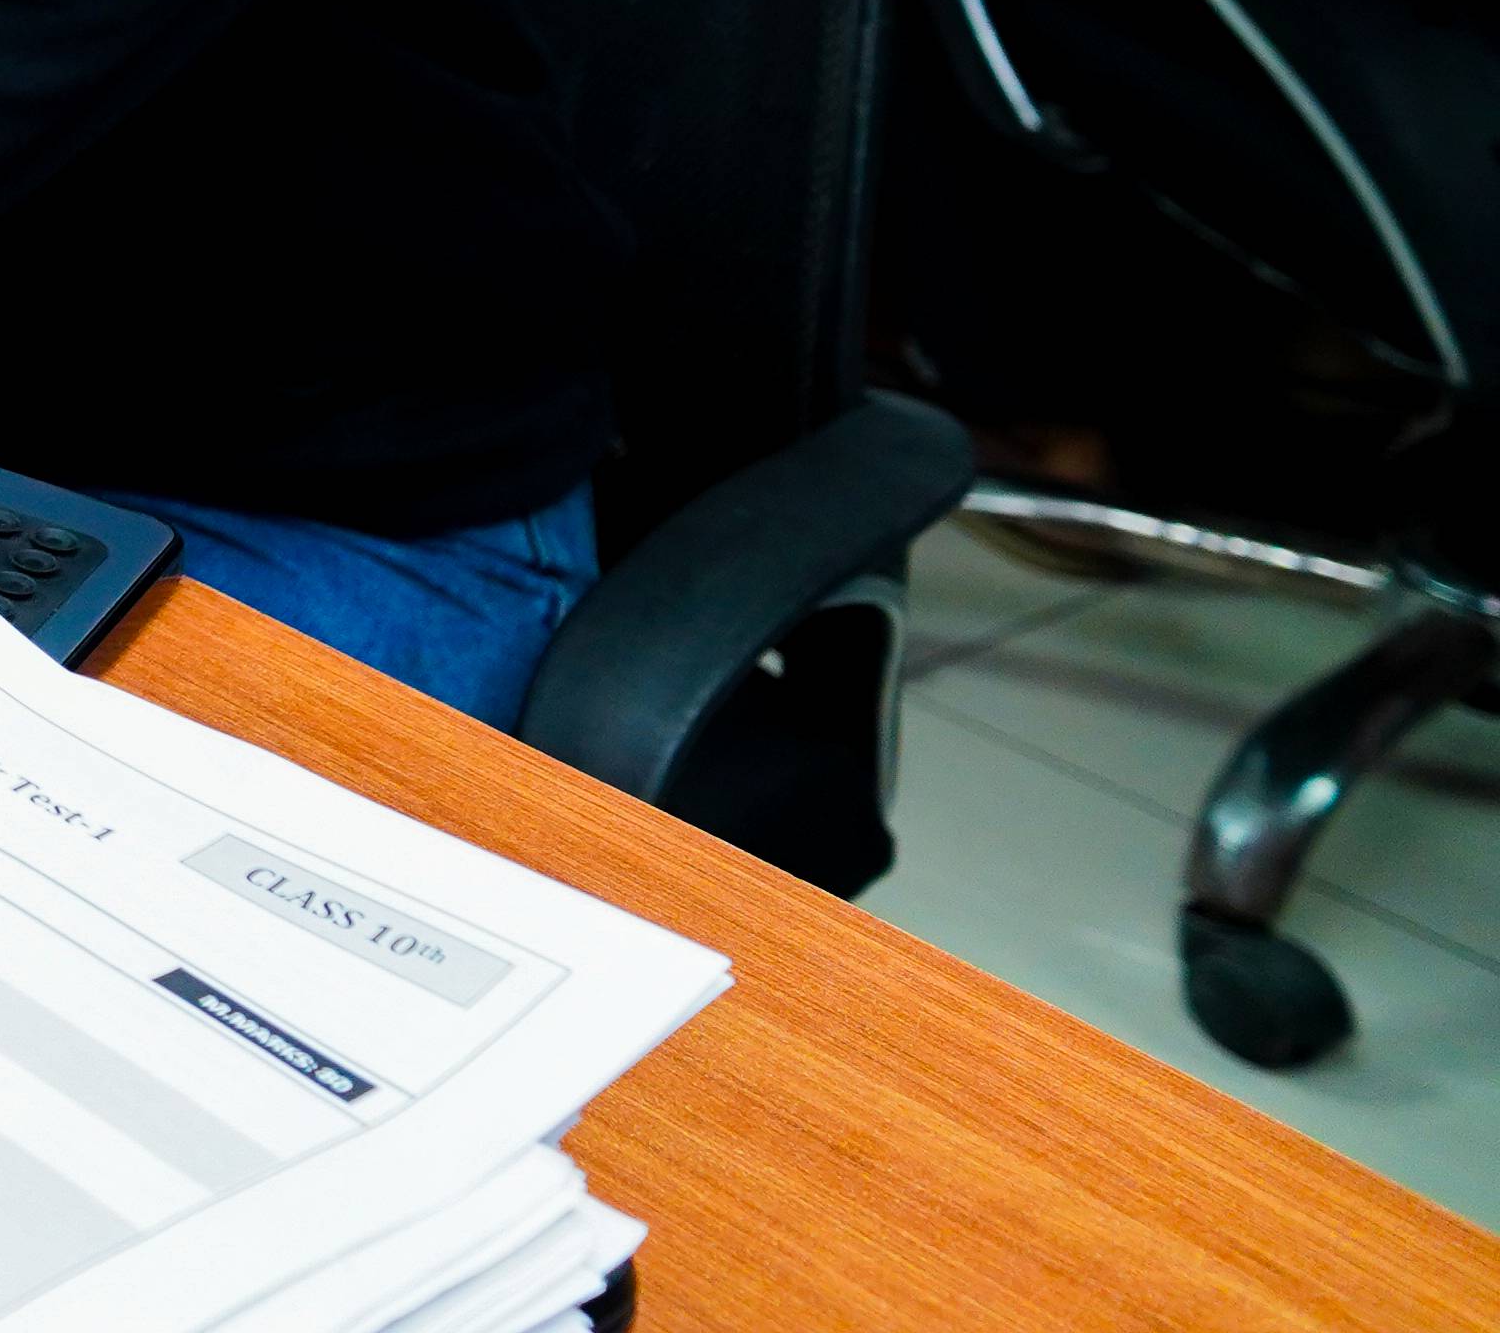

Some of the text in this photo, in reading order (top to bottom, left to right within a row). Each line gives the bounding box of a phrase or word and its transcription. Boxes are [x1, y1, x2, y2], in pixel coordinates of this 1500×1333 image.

[10, 777, 117, 843] Test-1
[244, 865, 448, 968] CLASS 10th
[314, 1063, 355, 1097] 80
